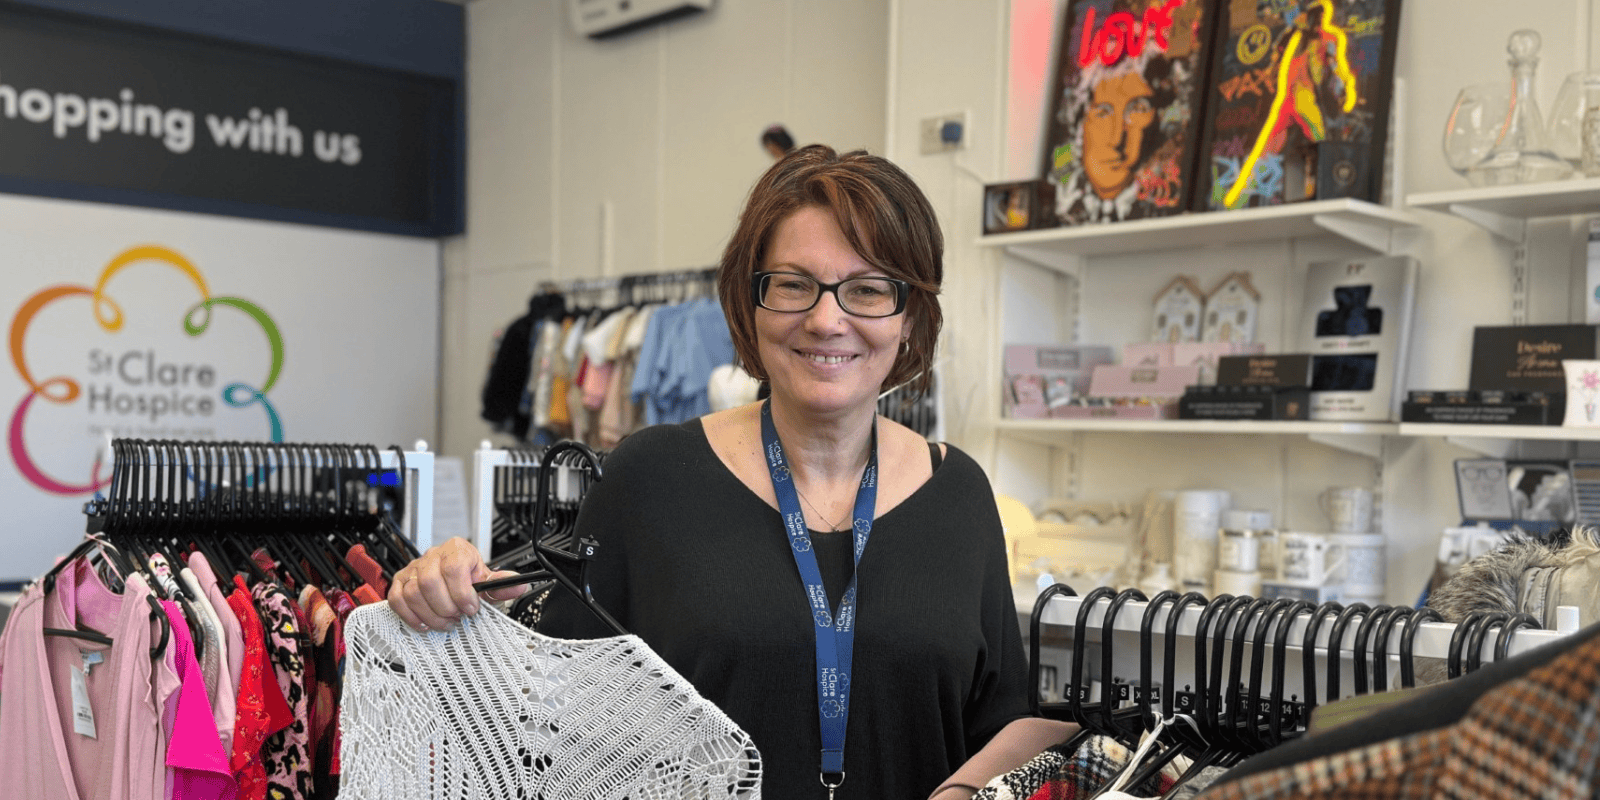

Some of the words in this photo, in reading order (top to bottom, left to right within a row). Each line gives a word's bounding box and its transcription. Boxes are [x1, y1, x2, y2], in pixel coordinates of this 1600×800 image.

[205, 107, 303, 157] with
[313, 130, 362, 165] us
[117, 349, 216, 388] Clare
[88, 384, 216, 422] Hospice
[786, 513, 797, 536] Hospice
[795, 517, 804, 535] Clare
[586, 547, 594, 556] S
[808, 584, 819, 608] Hospice
[816, 588, 825, 609] Clare
[837, 606, 847, 626] Clare
[843, 605, 852, 632] Hospice
[820, 667, 829, 697] Hospice
[828, 674, 838, 697] Clare
[1120, 688, 1127, 697] S
[1181, 696, 1189, 706] S
[1260, 703, 1270, 712] 12
[1282, 704, 1292, 715] 14
